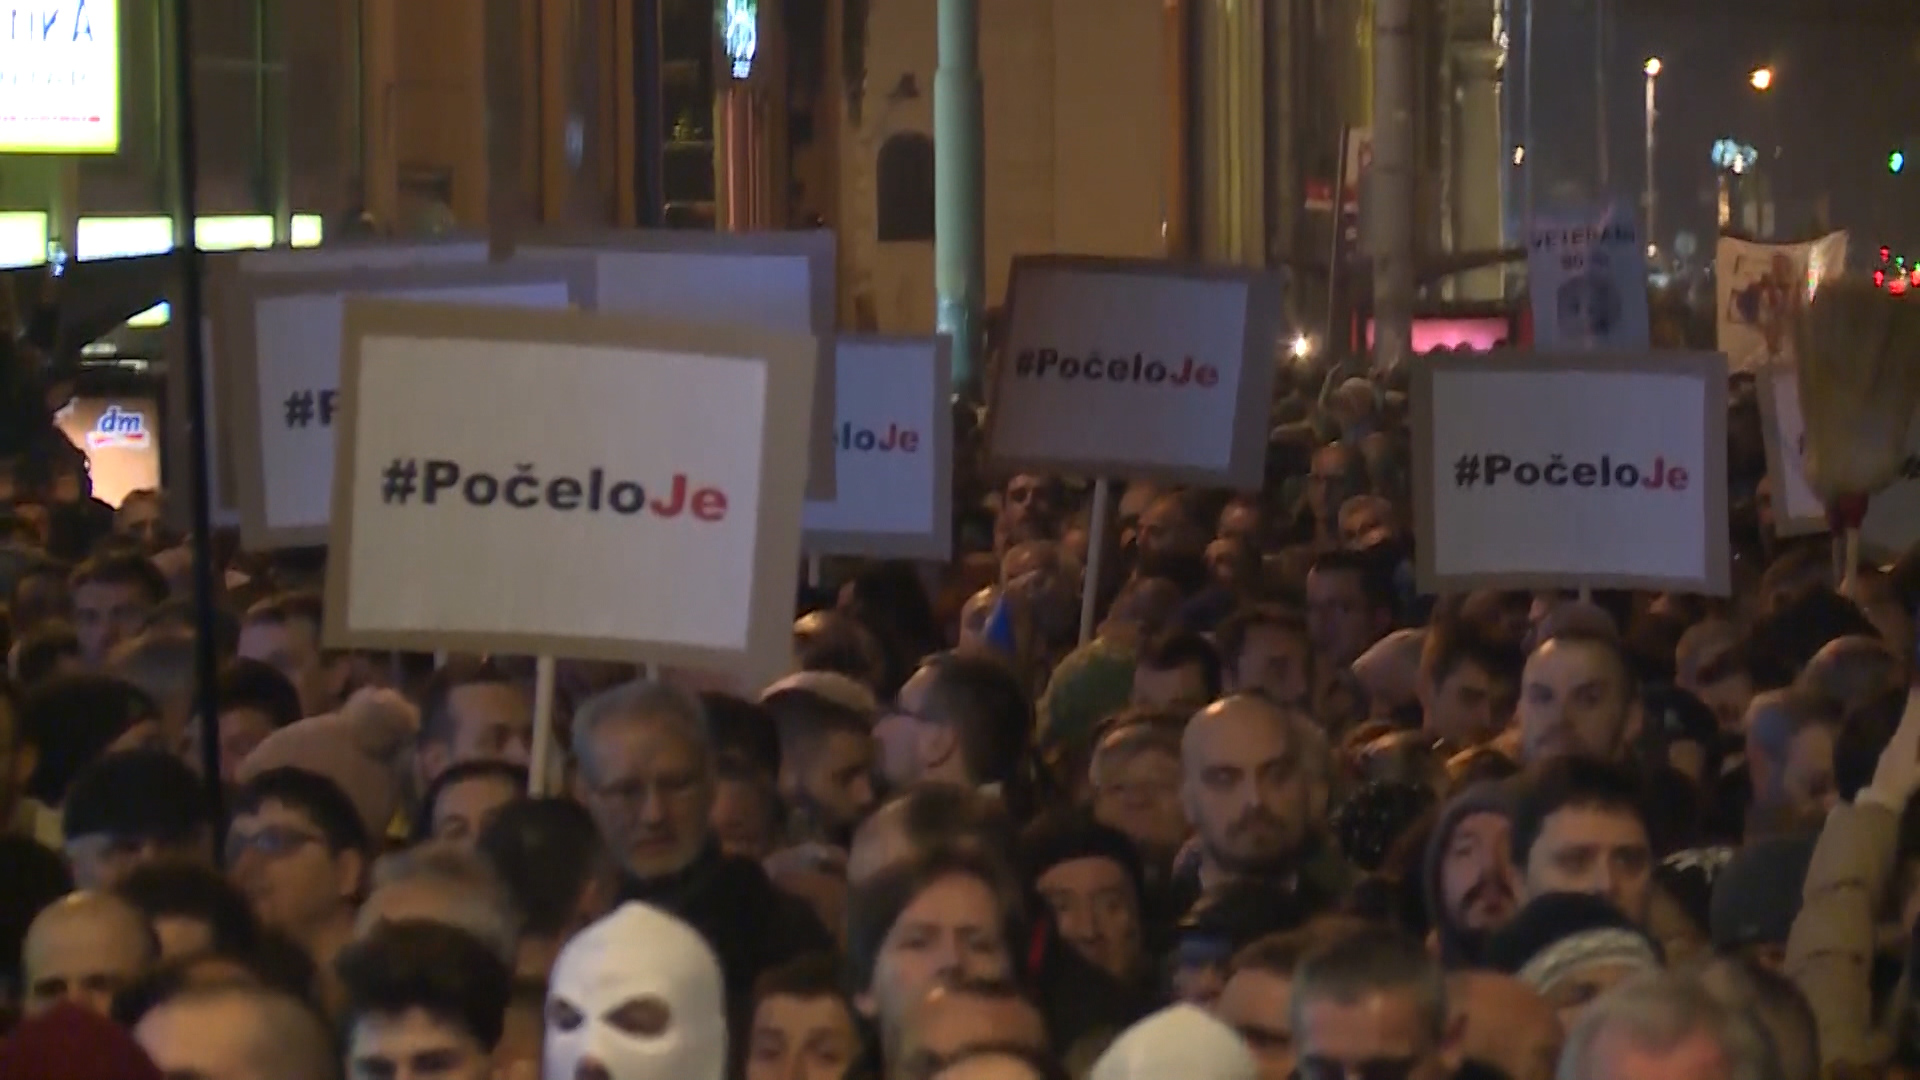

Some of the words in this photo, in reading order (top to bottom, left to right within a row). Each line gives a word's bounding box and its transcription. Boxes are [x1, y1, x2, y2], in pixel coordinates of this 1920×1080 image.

[1015, 347, 1219, 387] #PočeloJe
[101, 408, 140, 432] dm
[832, 421, 920, 452] loJe
[378, 458, 728, 522] #PočeloJe
[1453, 453, 1689, 491] #PočeloJe
